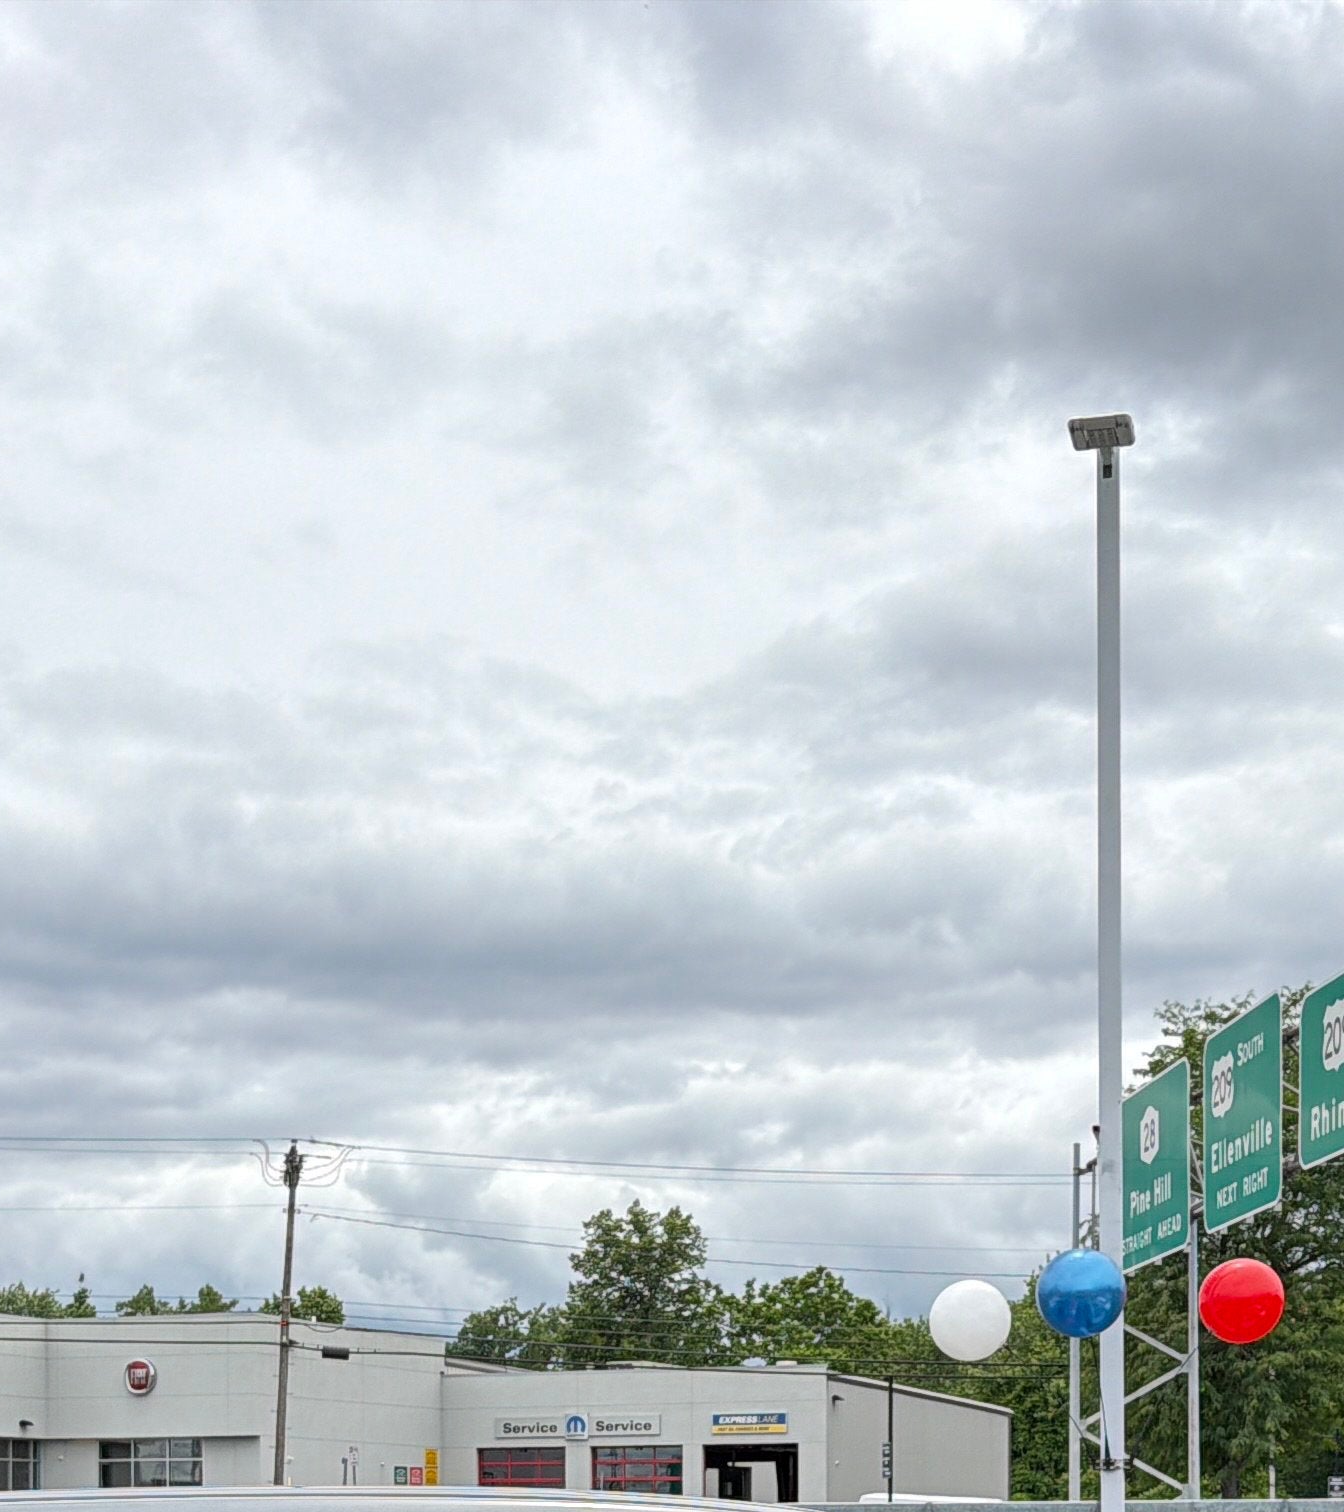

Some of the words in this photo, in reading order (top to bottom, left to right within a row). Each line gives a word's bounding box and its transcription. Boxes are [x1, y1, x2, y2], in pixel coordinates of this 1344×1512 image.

[1237, 1032, 1264, 1067] SOUTH
[1212, 1066, 1232, 1109] 209
[1143, 1115, 1156, 1153] 28
[1211, 1116, 1272, 1174] Ellenville
[1130, 1190, 1151, 1219] Pine
[1153, 1172, 1172, 1207] Hill
[1216, 1181, 1238, 1210] NEXT
[1243, 1167, 1269, 1197] RIGHT
[1122, 1226, 1153, 1256] STRAIGHT
[1157, 1213, 1182, 1240] AHEAD
[503, 1422, 558, 1434] Service
[595, 1420, 652, 1432] Service
